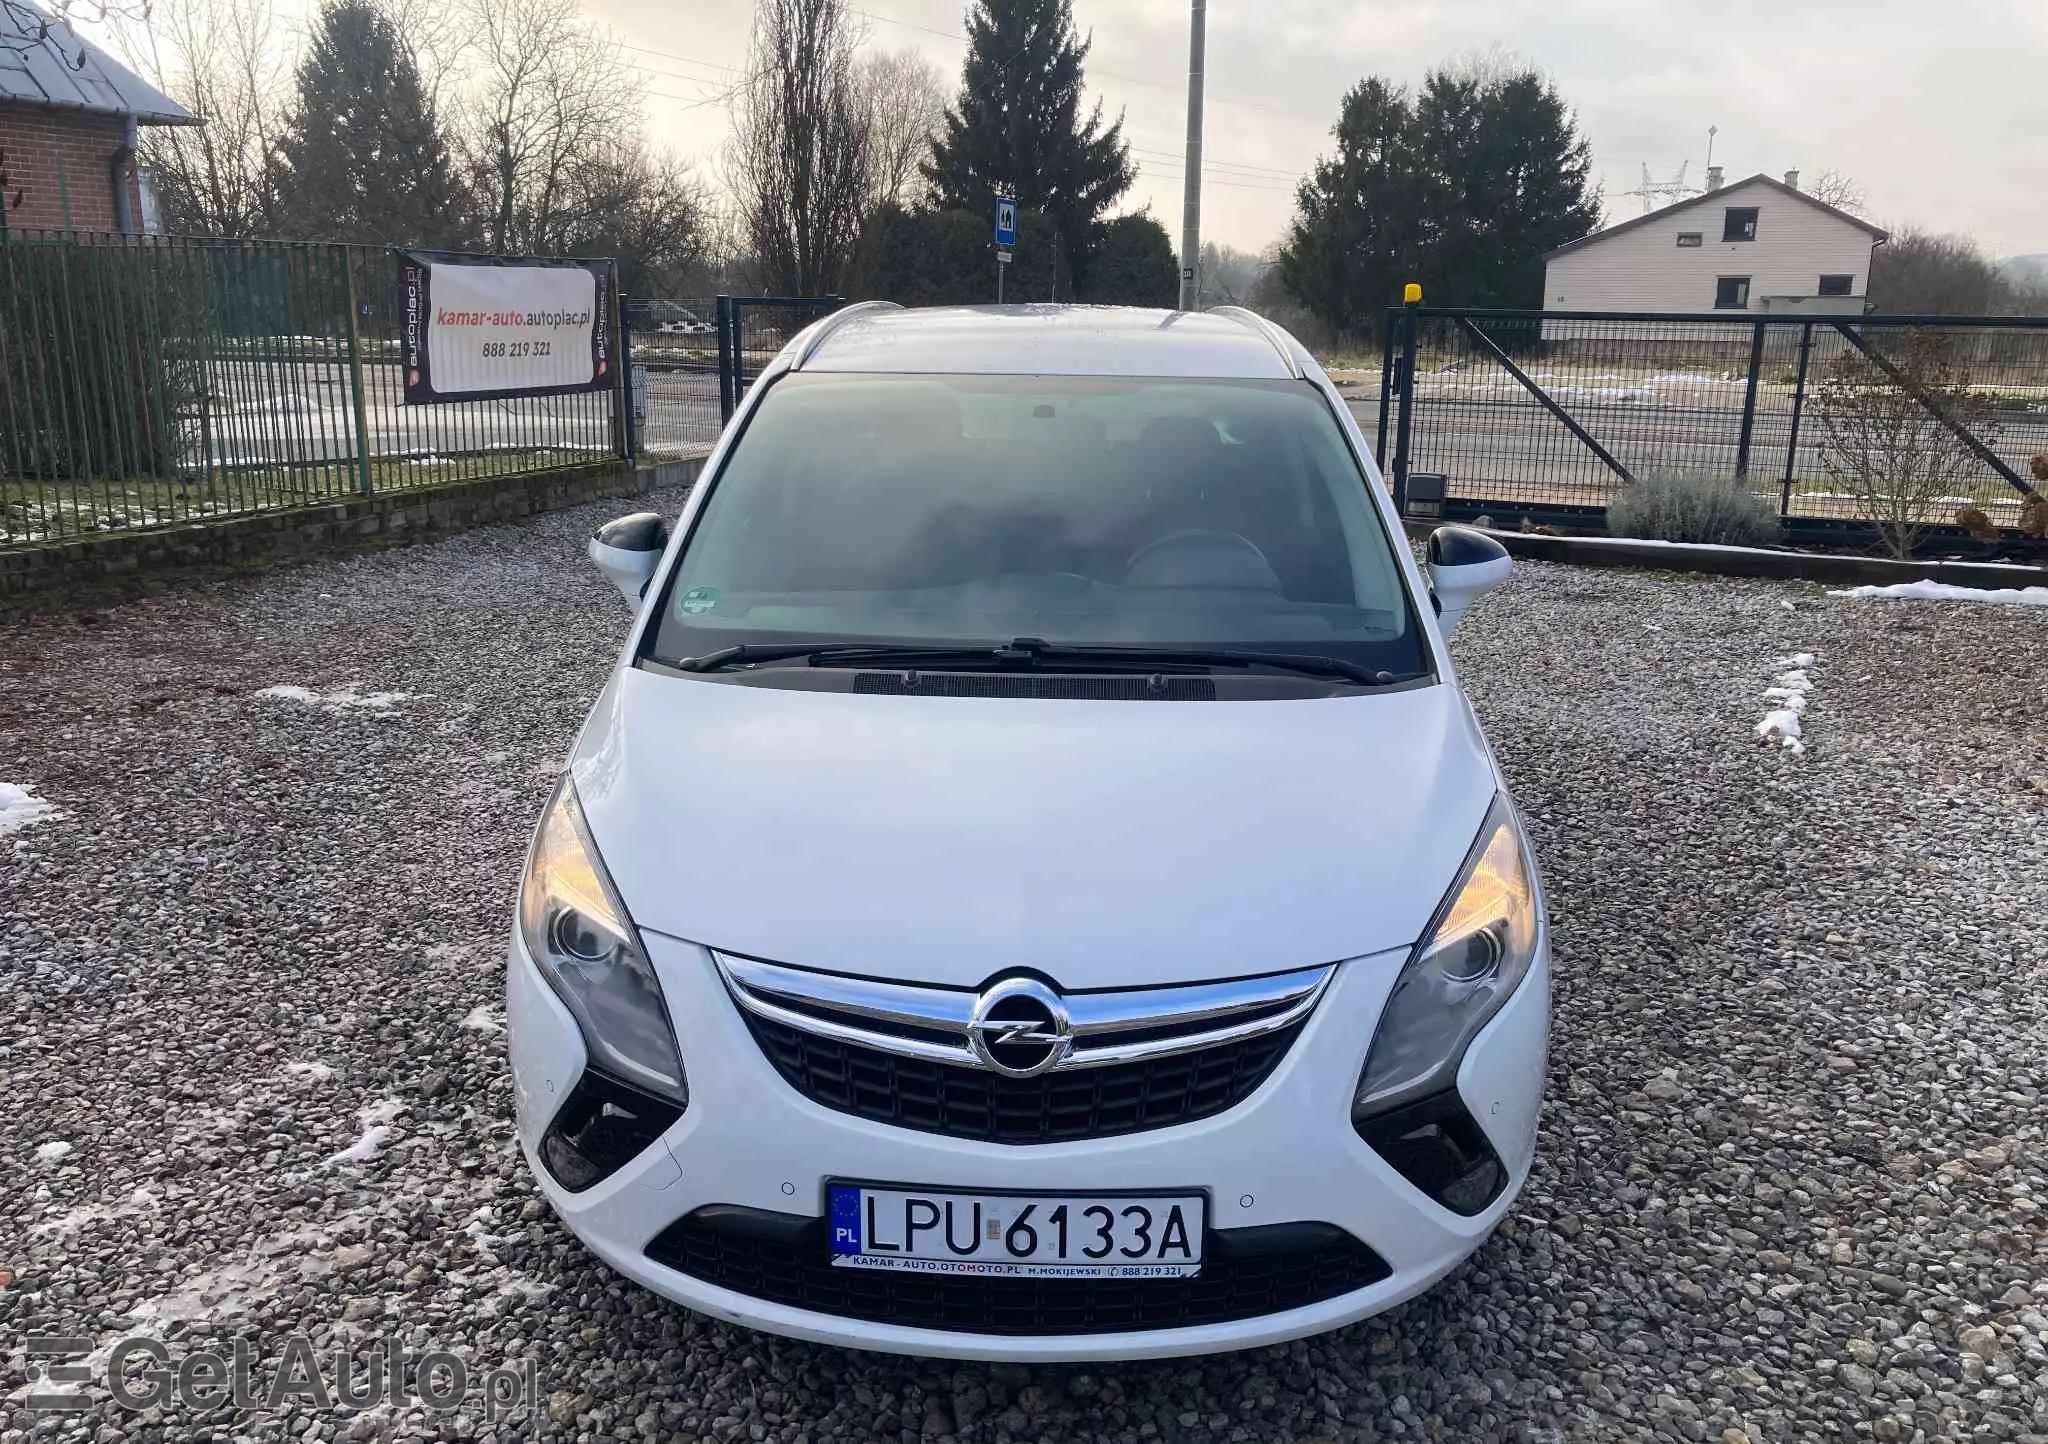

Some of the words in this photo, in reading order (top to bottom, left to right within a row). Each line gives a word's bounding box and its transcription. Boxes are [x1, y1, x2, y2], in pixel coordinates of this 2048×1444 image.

[407, 267, 417, 367] autoplac.pl
[437, 307, 591, 330] kamar-auto.autoplac.pl
[482, 342, 506, 357] 888
[509, 342, 529, 357] 219
[532, 341, 551, 356] 321
[867, 1196, 981, 1255] LPU
[1005, 1204, 1192, 1259] 6133A
[835, 1228, 858, 1244] PL
[853, 1256, 894, 1267] KAMAR
[1121, 1267, 1140, 1276] 888
[1143, 1267, 1162, 1276] 219
[1165, 1266, 1181, 1275] 321
